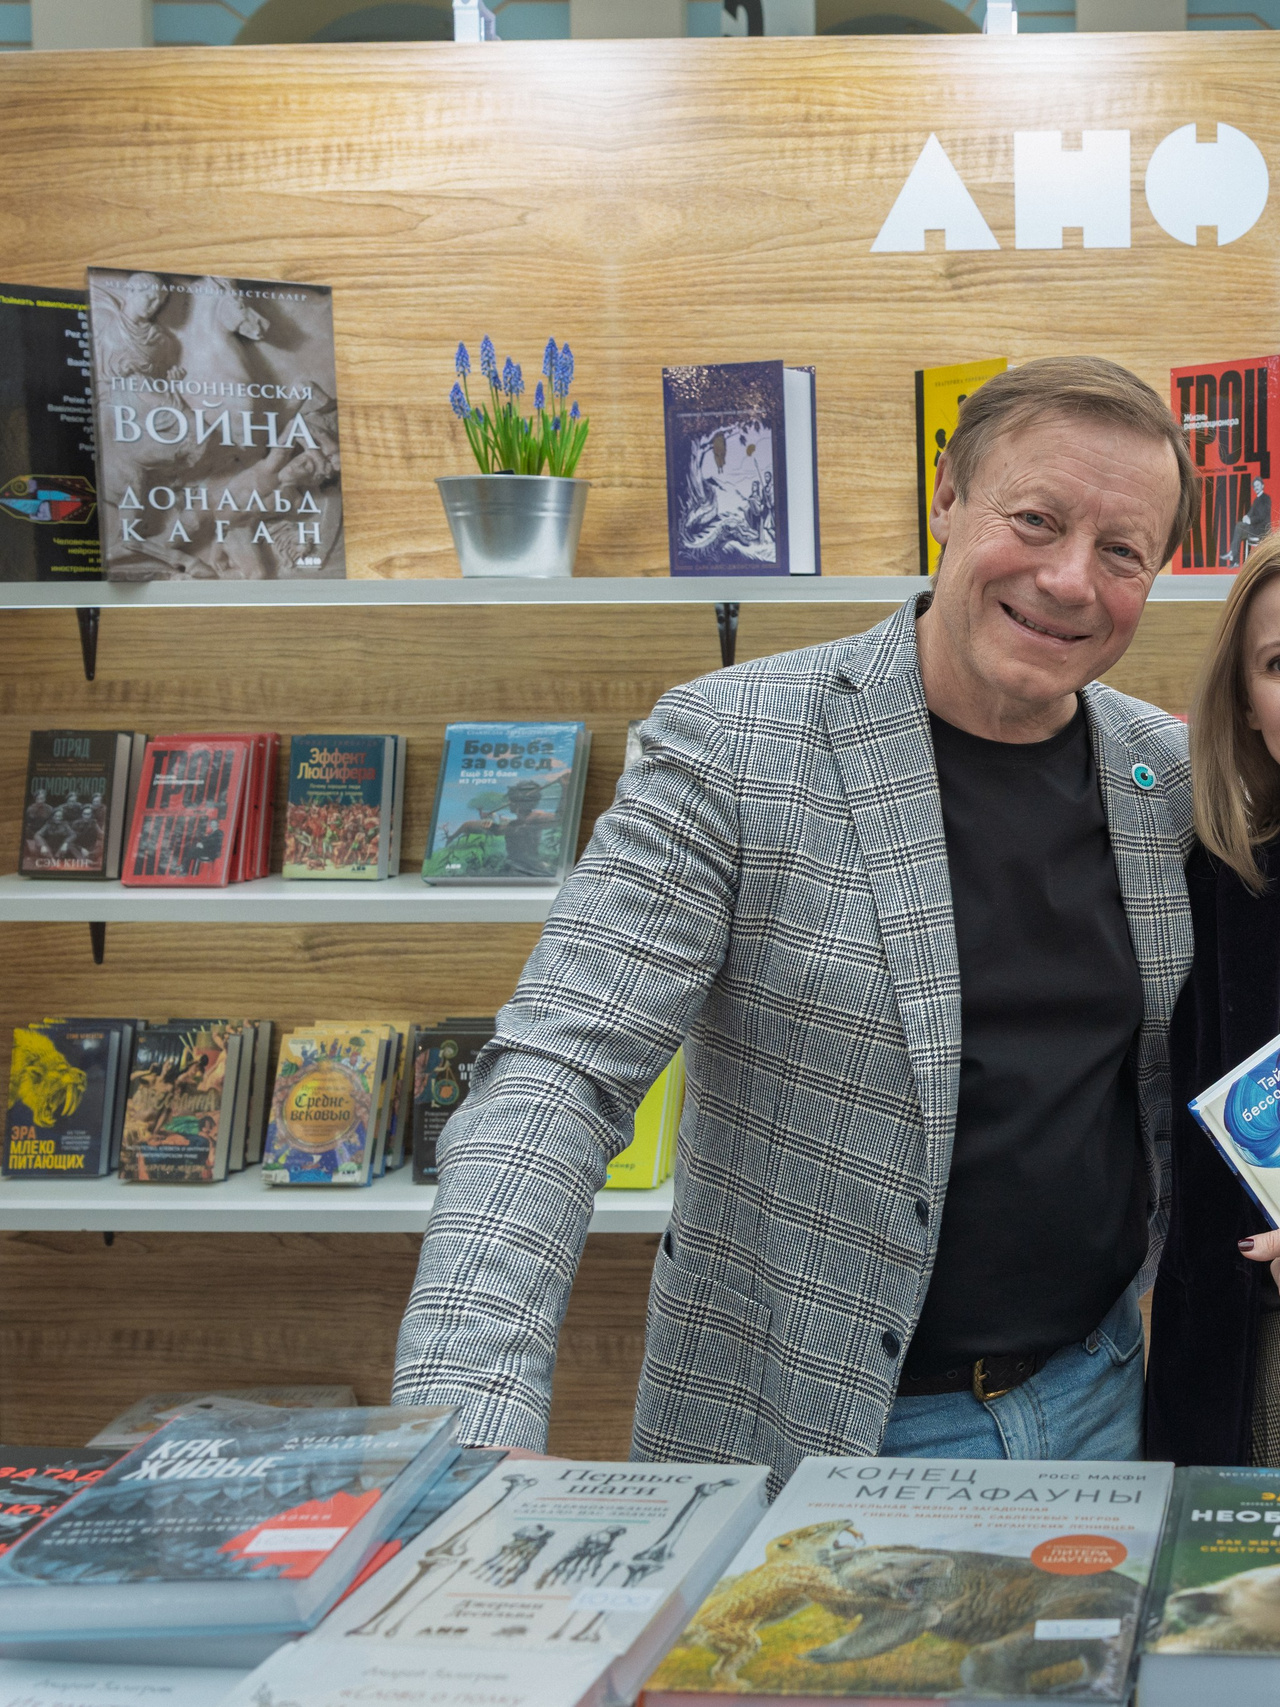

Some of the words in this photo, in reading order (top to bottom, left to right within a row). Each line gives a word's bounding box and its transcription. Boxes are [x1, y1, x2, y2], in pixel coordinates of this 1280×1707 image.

[229, 287, 307, 302] БЕСТСЕЛЛЕР
[111, 376, 313, 401] ПЕЛОПОННЕССКАЯ
[108, 400, 321, 450] ВОЙНА
[1177, 367, 1270, 479] ТРОЦ
[119, 486, 321, 514] ДОНАЛЬД
[121, 518, 322, 544] КАГАН
[53, 738, 91, 758] ОТРЯД
[309, 747, 367, 767] Эффект
[463, 739, 554, 758] Борьба
[461, 757, 486, 769] за
[496, 755, 552, 771] обед
[296, 762, 376, 784] Люцифера
[30, 776, 107, 796] ОТМОРОЗКОВ
[146, 750, 235, 820] ТРОЦ
[35, 857, 61, 868] СЭМ
[294, 1093, 350, 1109] Средне-
[290, 1108, 350, 1121] вековью
[11, 1125, 36, 1140] ЭРА
[10, 1139, 56, 1155] МЛЕКО
[8, 1154, 85, 1170] ПИТАЮЩИХ
[146, 1437, 236, 1459] КАК
[119, 1455, 285, 1482] ЖИВЫЕ
[557, 1468, 693, 1486] Первые
[826, 1466, 978, 1485] КОНЕЦ
[1087, 1473, 1147, 1482] МАКФИ
[565, 1484, 659, 1498] шаги
[854, 1484, 1143, 1504] МЕГАФАУНЫ
[807, 1502, 907, 1510] УВЛЕКАТЕЛЬНАЯ
[911, 1504, 957, 1512] ЖИЗНЬ
[971, 1505, 1050, 1513] ЗАГАДОЧНАЯ
[1051, 1549, 1109, 1558] ПИТЕРА
[1200, 1545, 1271, 1554] СКРЫТУЮ
[1041, 1556, 1114, 1565] ШАУТЕНА
